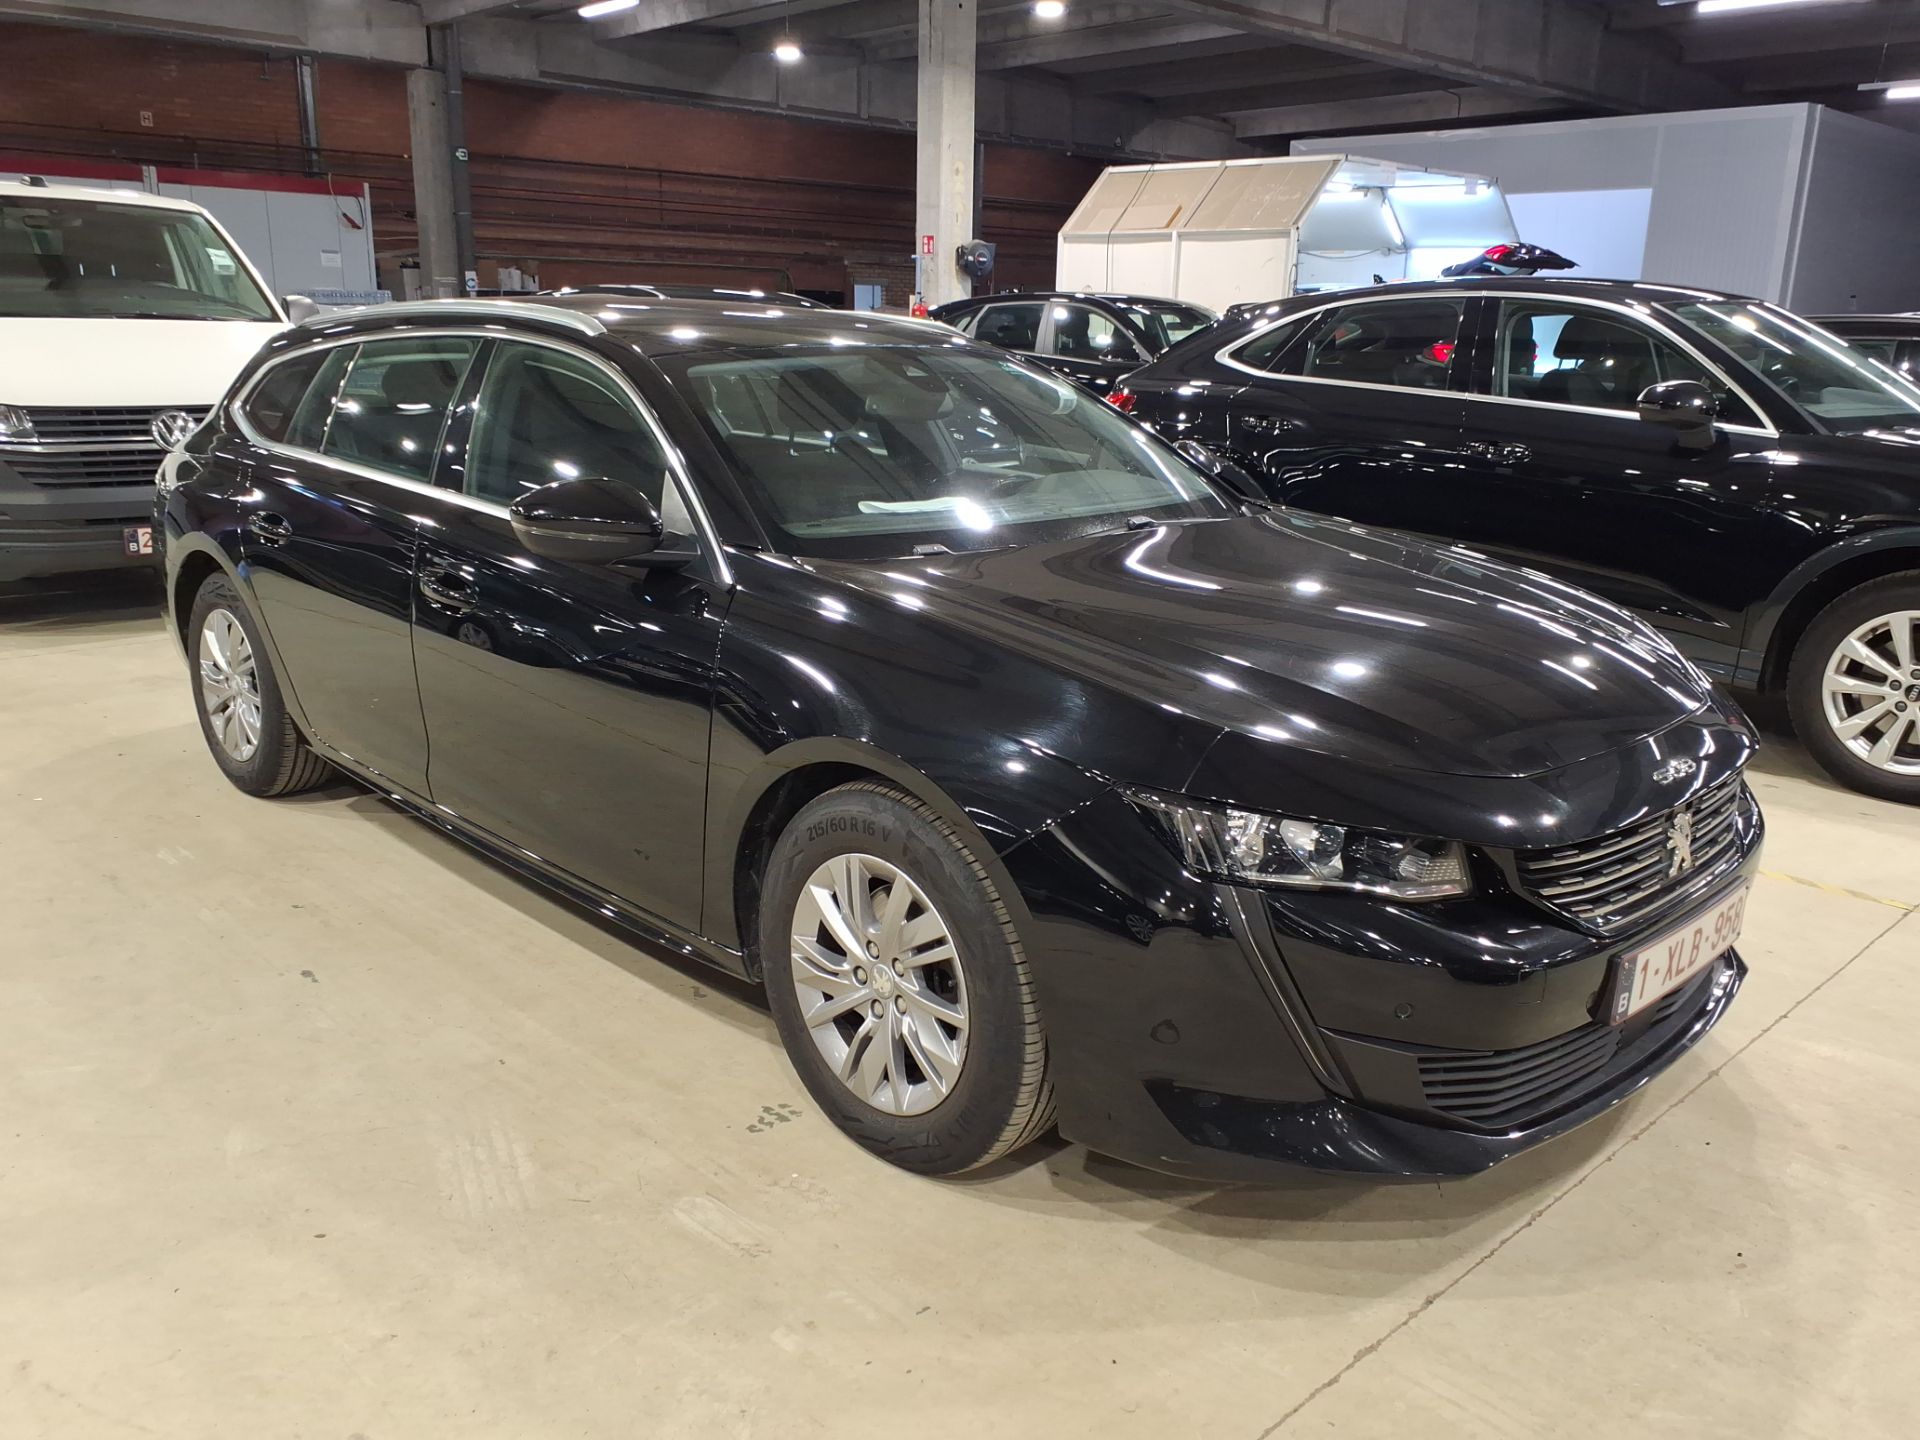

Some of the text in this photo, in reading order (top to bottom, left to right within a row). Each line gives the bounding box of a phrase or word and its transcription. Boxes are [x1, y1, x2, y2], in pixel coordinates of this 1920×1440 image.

[129, 543, 138, 551] B
[807, 817, 847, 842] 215/60
[850, 817, 859, 832] R
[863, 819, 876, 836] 16
[1617, 991, 1629, 1013] B
